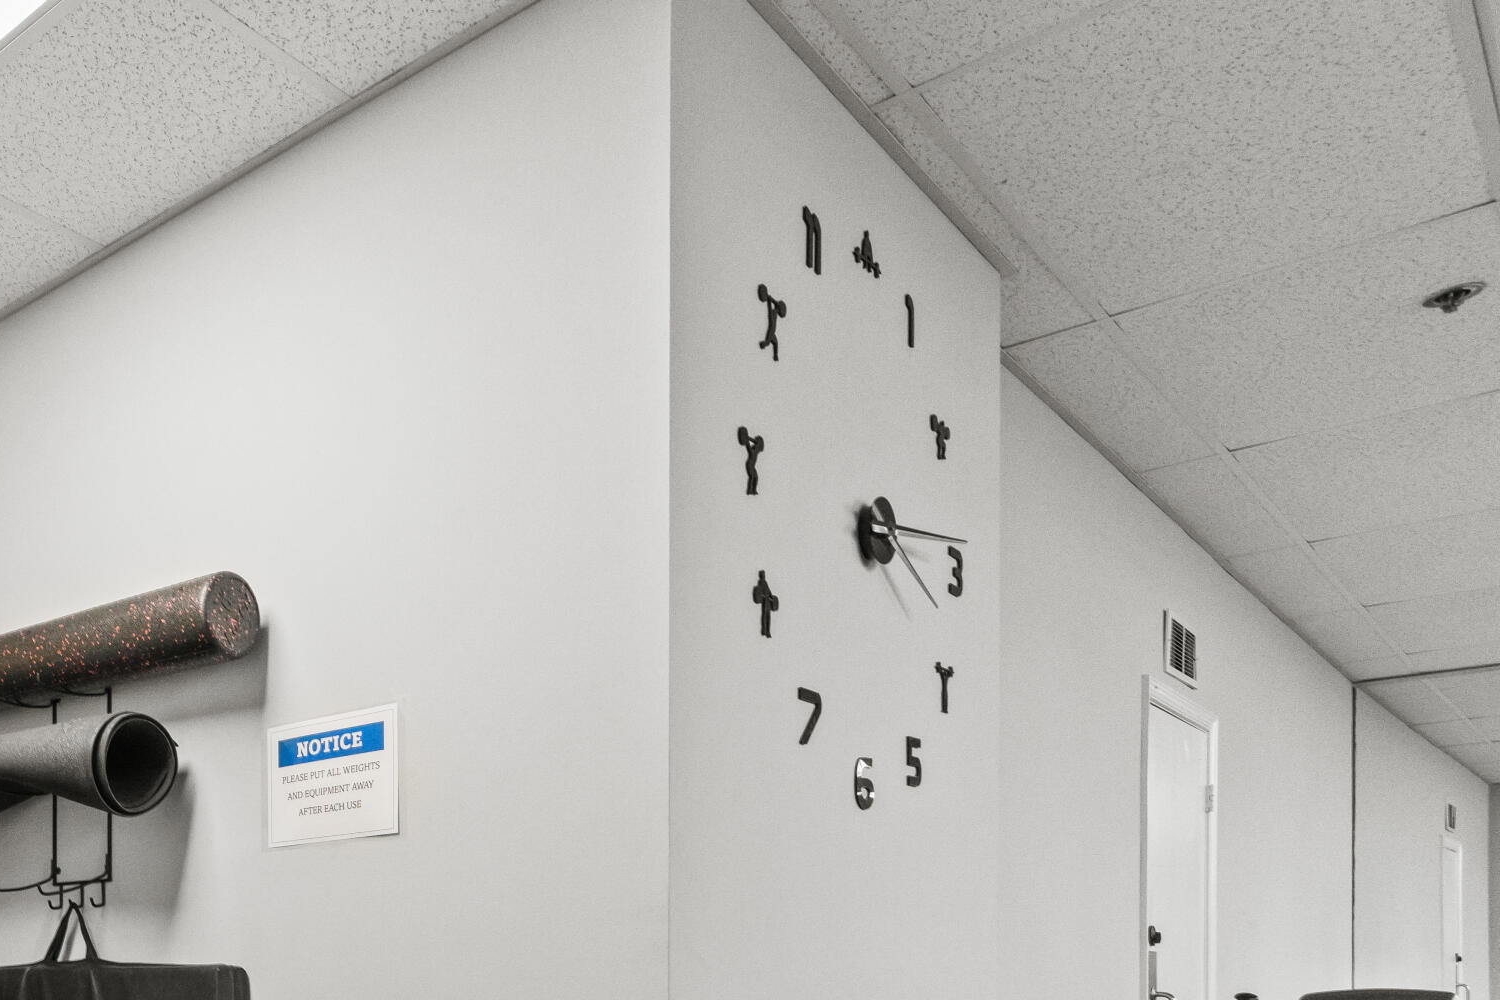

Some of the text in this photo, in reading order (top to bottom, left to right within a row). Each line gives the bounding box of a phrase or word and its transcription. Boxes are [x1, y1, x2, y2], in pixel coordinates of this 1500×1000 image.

[947, 545, 963, 597] 3
[797, 686, 822, 745] 7
[296, 731, 363, 758] NOTICE
[906, 735, 922, 787] 5
[282, 760, 380, 784] PLEASE PUT ALL WEIGHTS
[287, 780, 374, 800] AND EQUIPMENT AWAY
[854, 756, 875, 810] 6
[299, 799, 362, 816] AFTER EACH USE
